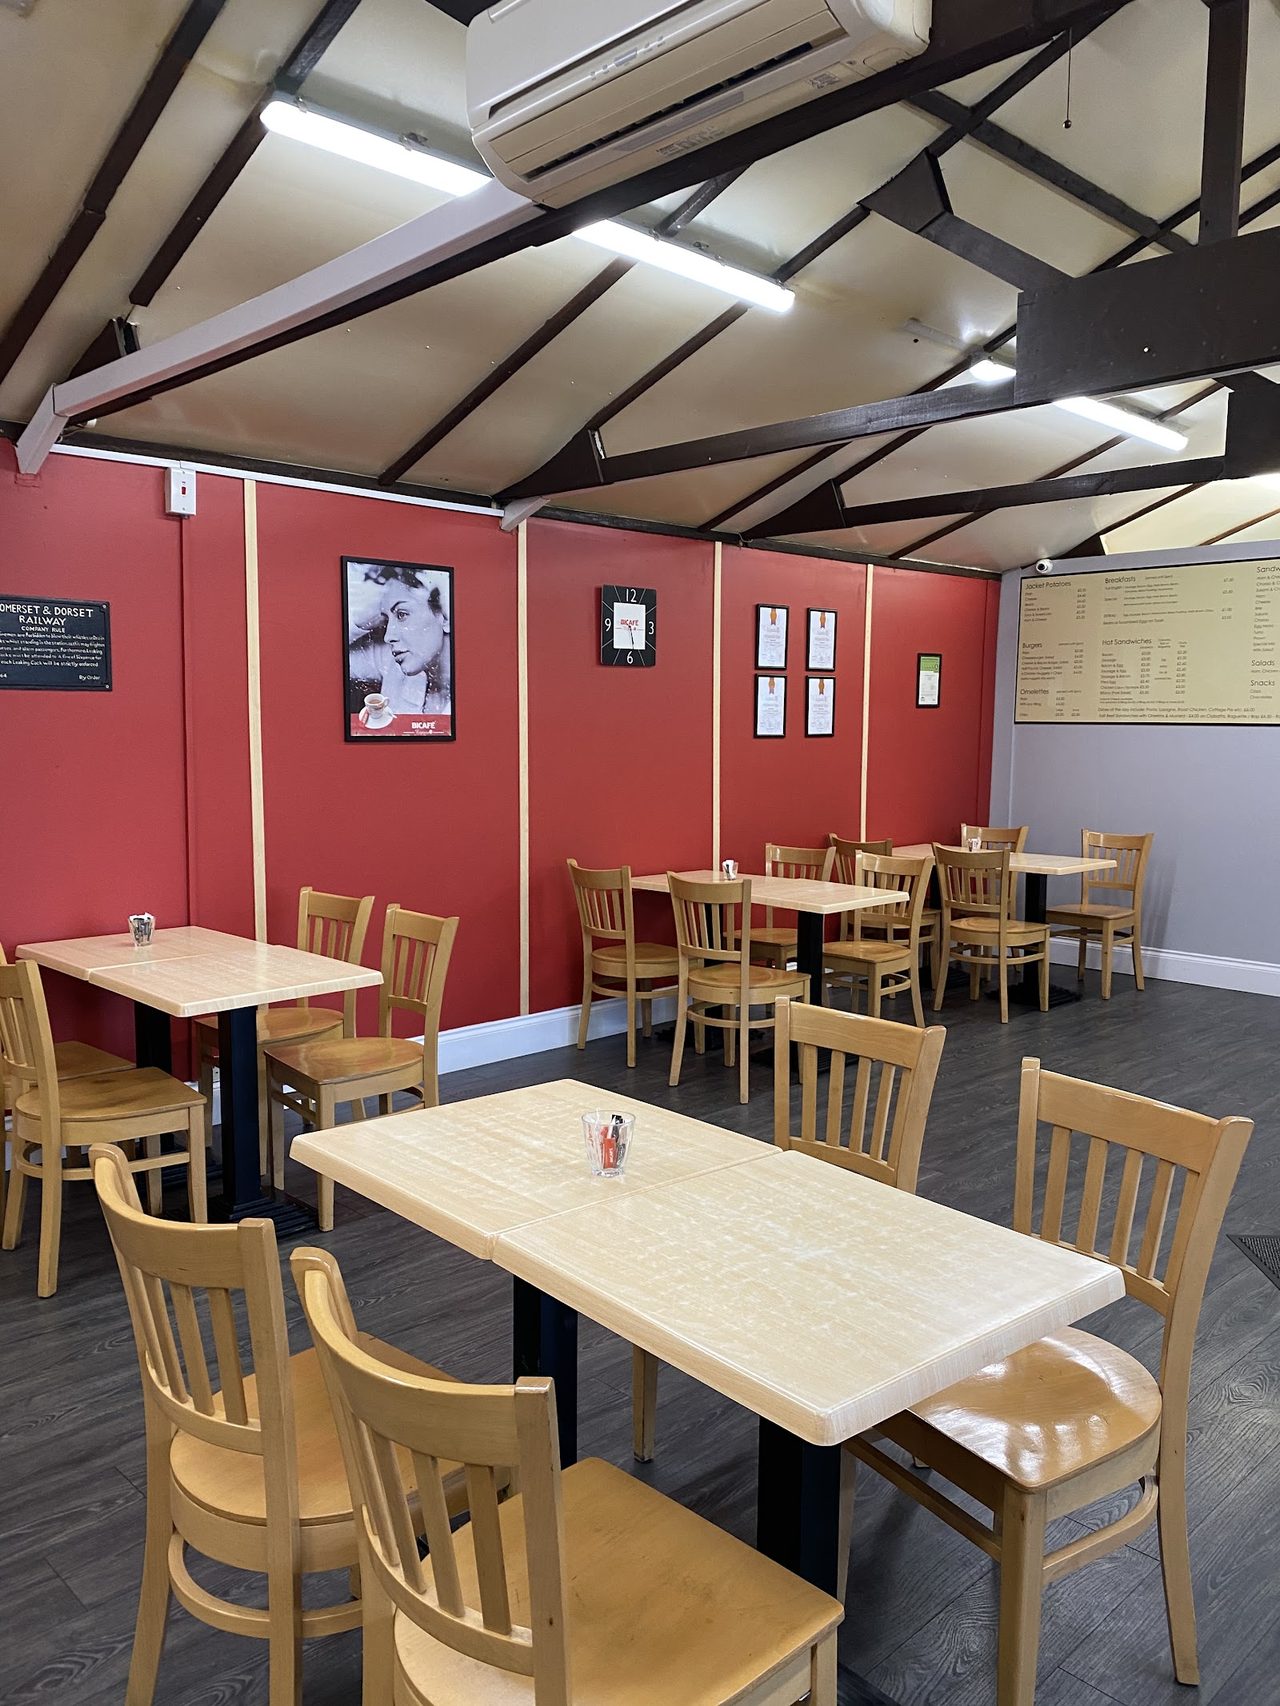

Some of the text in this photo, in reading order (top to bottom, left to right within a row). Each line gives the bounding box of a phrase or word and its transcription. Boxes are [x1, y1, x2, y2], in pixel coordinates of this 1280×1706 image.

[1105, 576, 1136, 584] Breakfasts
[626, 588, 637, 603] 12
[43, 605, 51, 615] &
[54, 606, 93, 618] DORSET
[19, 615, 66, 626] RAILWAY
[604, 618, 611, 631] 9
[648, 621, 655, 635] 3
[13, 659, 30, 667] Leaking
[626, 650, 633, 664] 6
